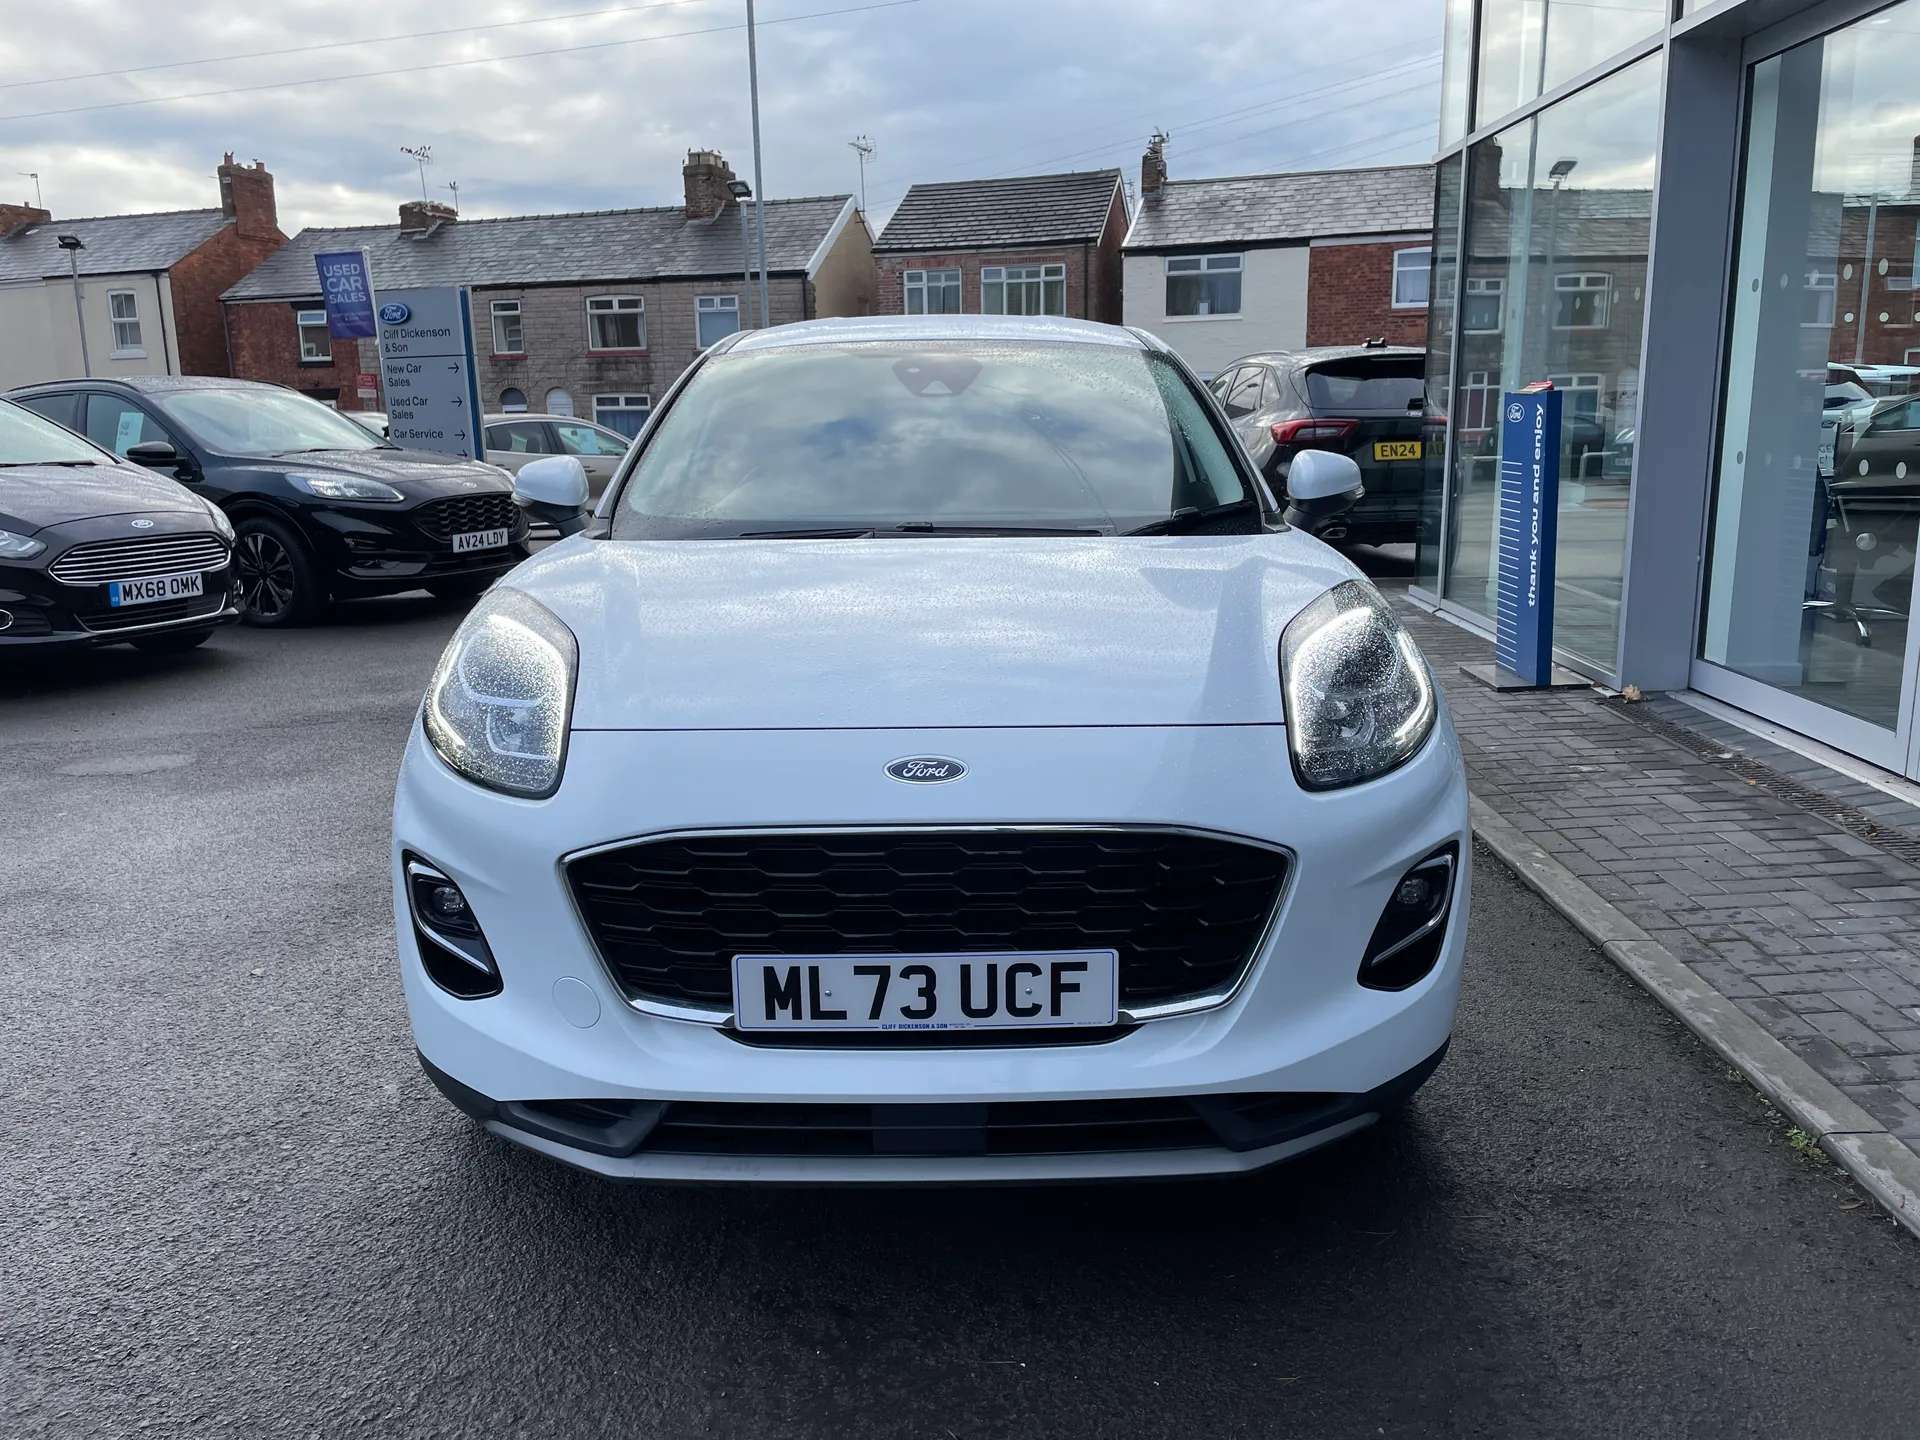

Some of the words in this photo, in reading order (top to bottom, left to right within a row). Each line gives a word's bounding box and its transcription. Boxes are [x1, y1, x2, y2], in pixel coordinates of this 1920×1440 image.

[323, 263, 360, 277] USED
[326, 276, 363, 292] CAR
[329, 292, 367, 304] SALES
[383, 329, 399, 339] Cliff
[400, 328, 451, 338] Dickenson
[385, 344, 391, 352] &
[392, 342, 408, 352] Son
[387, 364, 404, 374] New
[406, 363, 422, 373] Car
[388, 377, 411, 387] Sales
[390, 397, 411, 406] Used
[412, 396, 428, 406] Car
[392, 410, 414, 420] Sales
[394, 429, 407, 439] Car
[409, 428, 444, 439] Service
[1534, 403, 1544, 461] enjoy
[1380, 443, 1417, 458] EN24
[1532, 464, 1540, 503] and
[1531, 507, 1539, 545] you
[458, 533, 484, 550] AV24
[487, 530, 504, 546] LDY
[1528, 551, 1537, 608] thank
[122, 580, 166, 601] MX68
[171, 575, 200, 594] OMK
[902, 760, 949, 777] Ford
[960, 961, 1088, 1019] UCF
